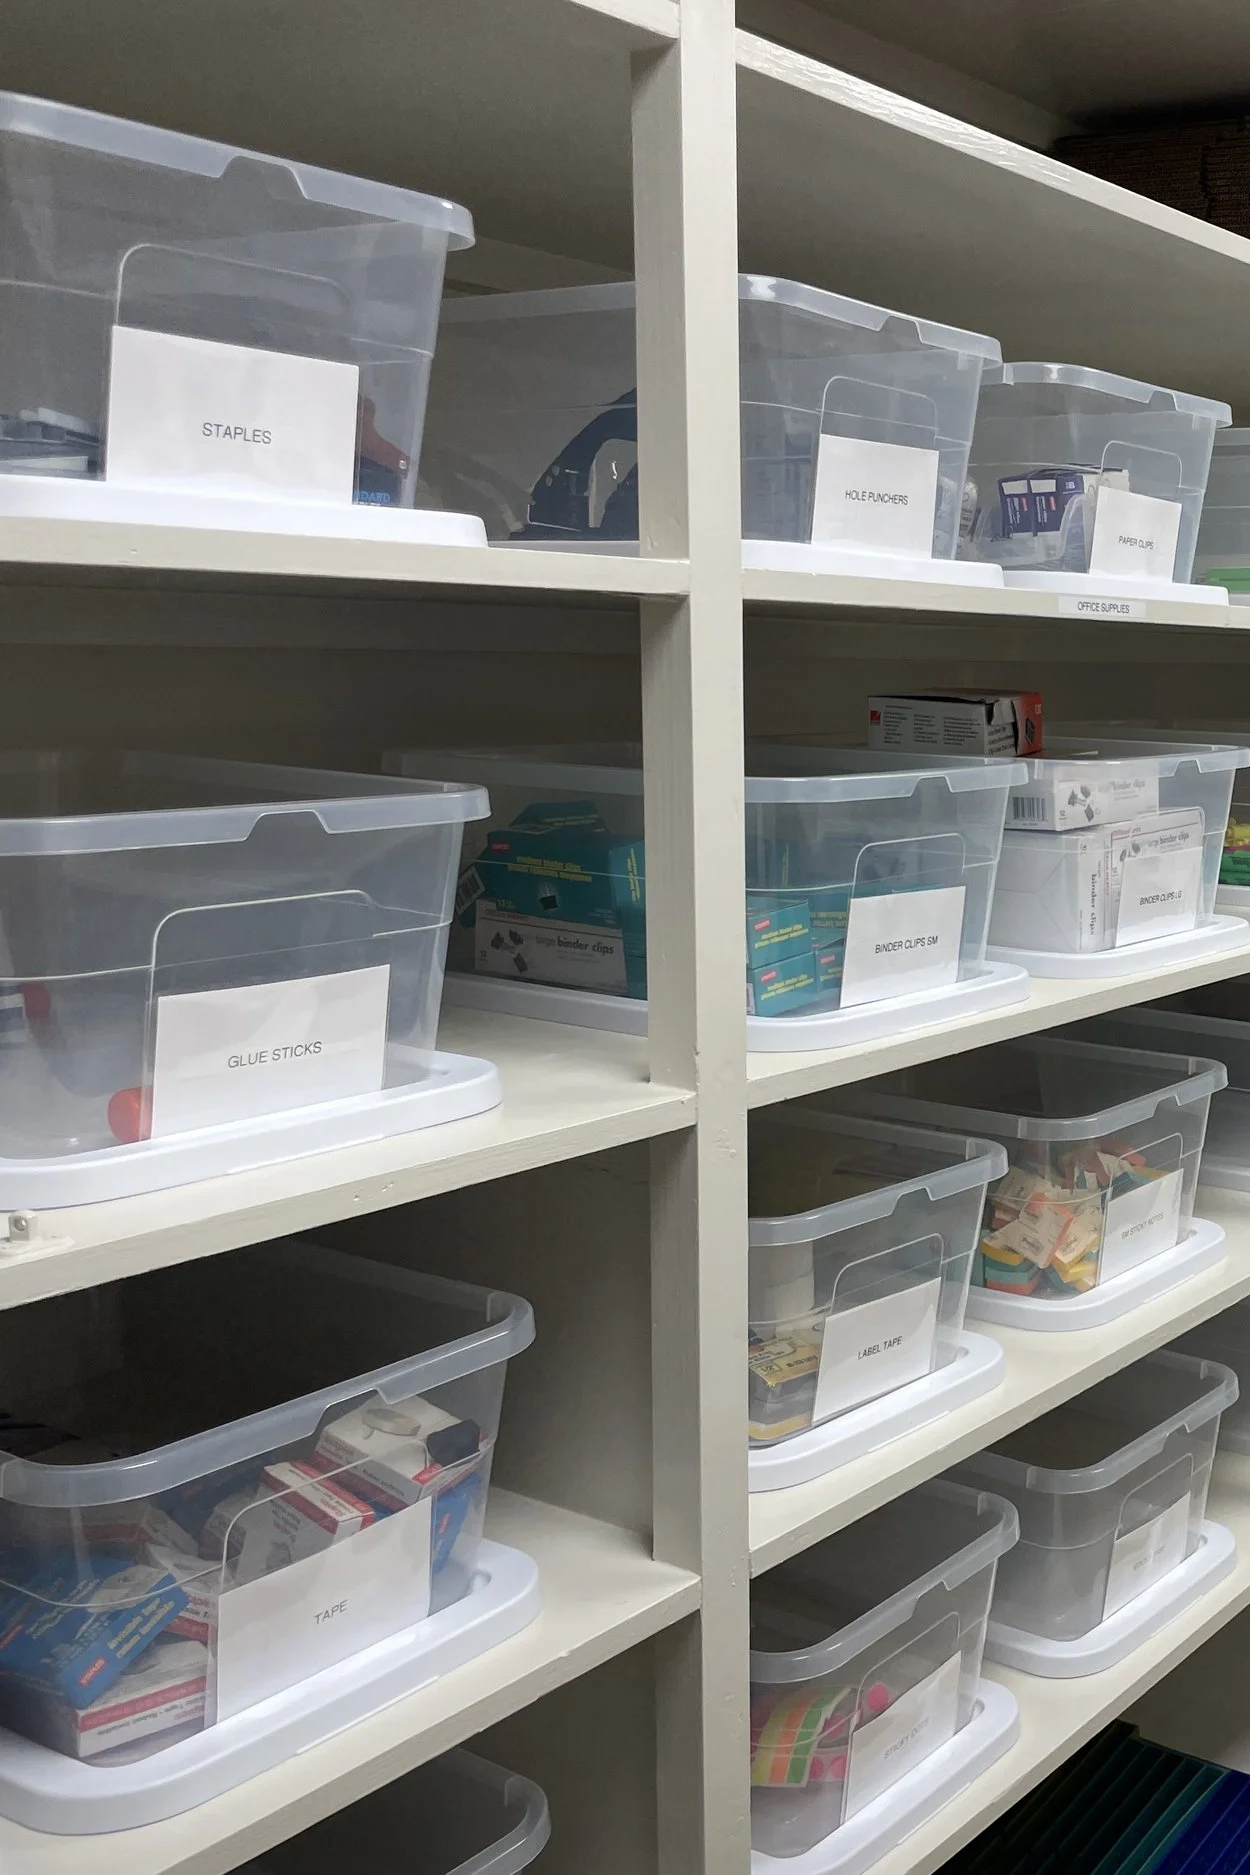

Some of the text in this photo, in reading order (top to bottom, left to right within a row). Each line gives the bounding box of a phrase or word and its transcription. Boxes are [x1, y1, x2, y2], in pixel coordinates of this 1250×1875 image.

[202, 422, 272, 445] STAPLES
[845, 489, 909, 506] HOLE PUNCHERS
[1118, 535, 1154, 550] PAPER CLIPS
[1077, 601, 1130, 614] OFFICE SUPPLIES
[1139, 894, 1160, 906] BINDER
[1160, 892, 1175, 902] CLIPS
[557, 935, 589, 951] binder
[592, 941, 614, 956] clips
[874, 935, 939, 954] BINDER CLIPS SM
[227, 1041, 323, 1068] GLUE STICKS
[1129, 1221, 1148, 1238] STICKY
[1147, 1212, 1165, 1229] NOTES
[857, 1336, 903, 1360] LABEL TAPE
[314, 1600, 348, 1625] TAPE
[884, 1732, 910, 1760] STICKY
